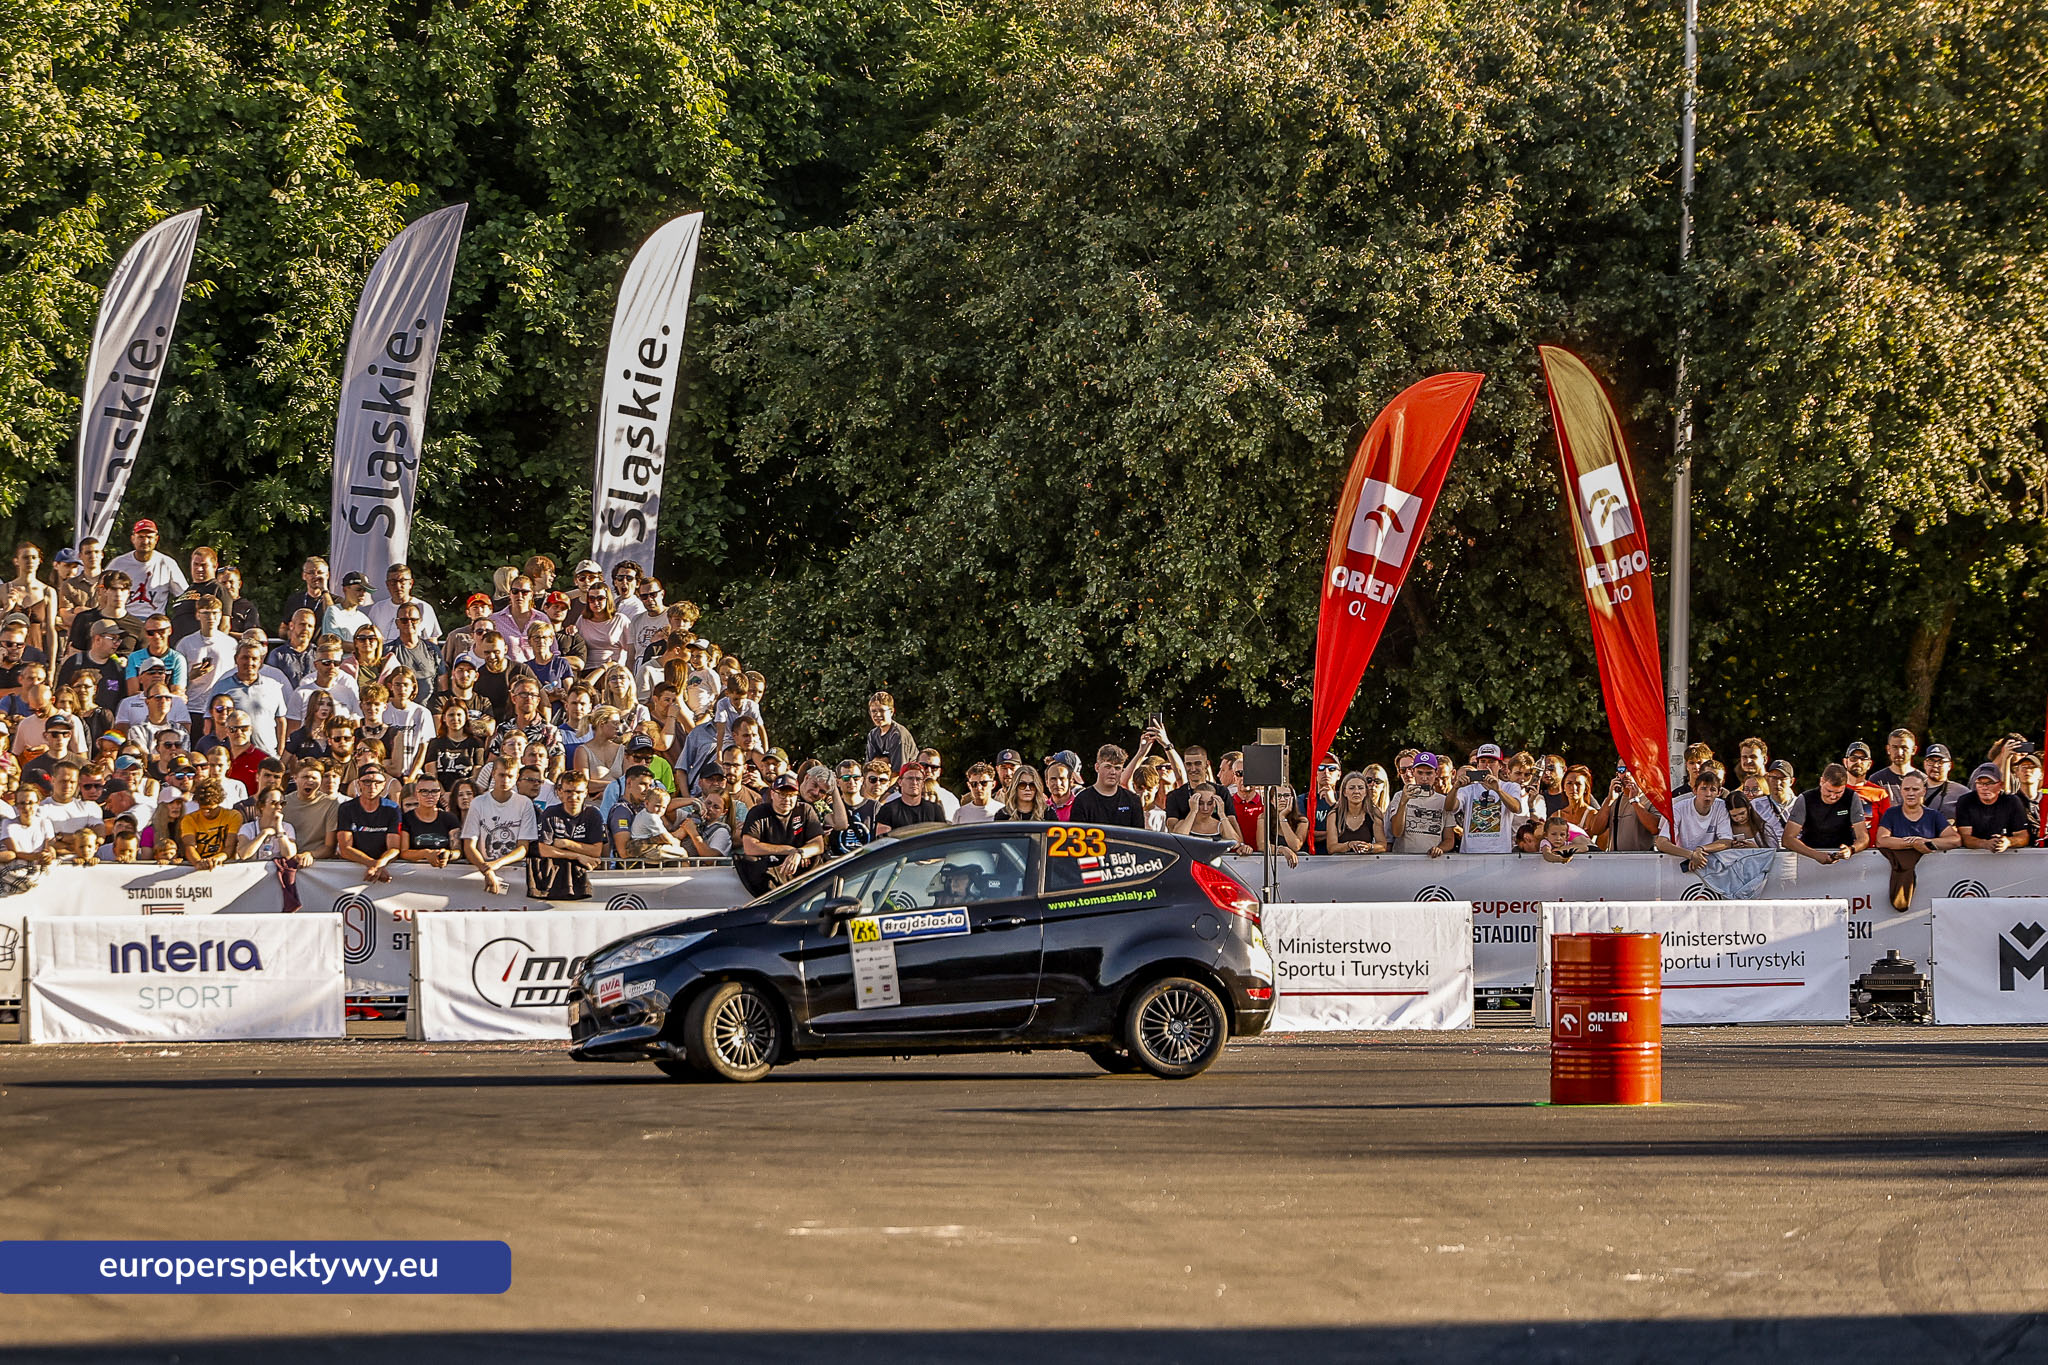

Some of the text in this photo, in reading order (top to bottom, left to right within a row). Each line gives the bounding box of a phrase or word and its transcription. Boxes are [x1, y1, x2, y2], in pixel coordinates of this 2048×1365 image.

[341, 318, 428, 539] Śląskie.
[601, 325, 670, 543] Śląskie.
[1046, 826, 1108, 857] 233
[1098, 855, 1110, 868] T.
[128, 884, 213, 902] STADION ŚLĄSKI
[1048, 888, 1157, 910] www.tomaszbialy.pl
[850, 919, 880, 943] 233
[883, 913, 964, 933] #rajdslaska
[110, 934, 264, 974] interia
[1278, 938, 1392, 954] Ministerstwo
[1277, 960, 1430, 980] Sportu i Turystyki
[1660, 951, 1805, 972] portu i Turystyki
[599, 978, 621, 994] AVIA
[139, 984, 239, 1010] SPORT
[1587, 1012, 1628, 1023] ORLEN
[1587, 1023, 1604, 1033] OIL
